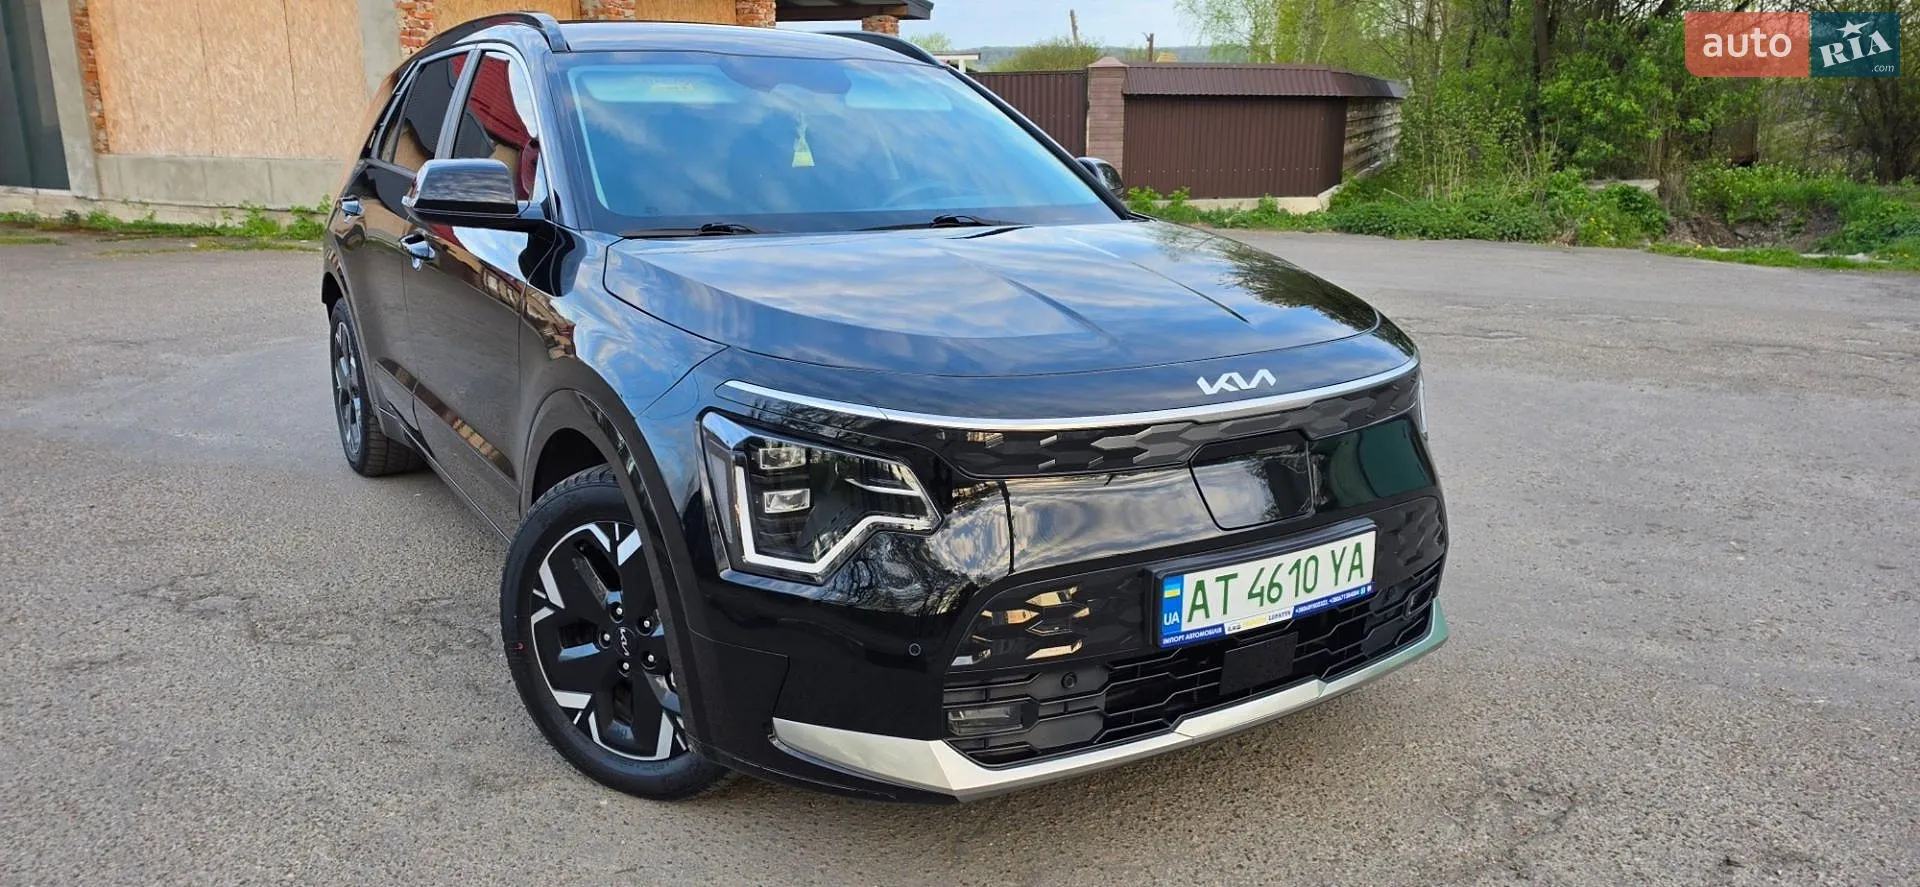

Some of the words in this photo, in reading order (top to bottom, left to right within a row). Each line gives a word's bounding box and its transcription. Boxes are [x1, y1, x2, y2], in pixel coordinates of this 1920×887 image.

[1196, 368, 1277, 395] KIA
[1187, 572, 1238, 623] AT
[1248, 554, 1319, 608] 4610
[1330, 542, 1364, 587] YA
[1163, 612, 1180, 626] UA
